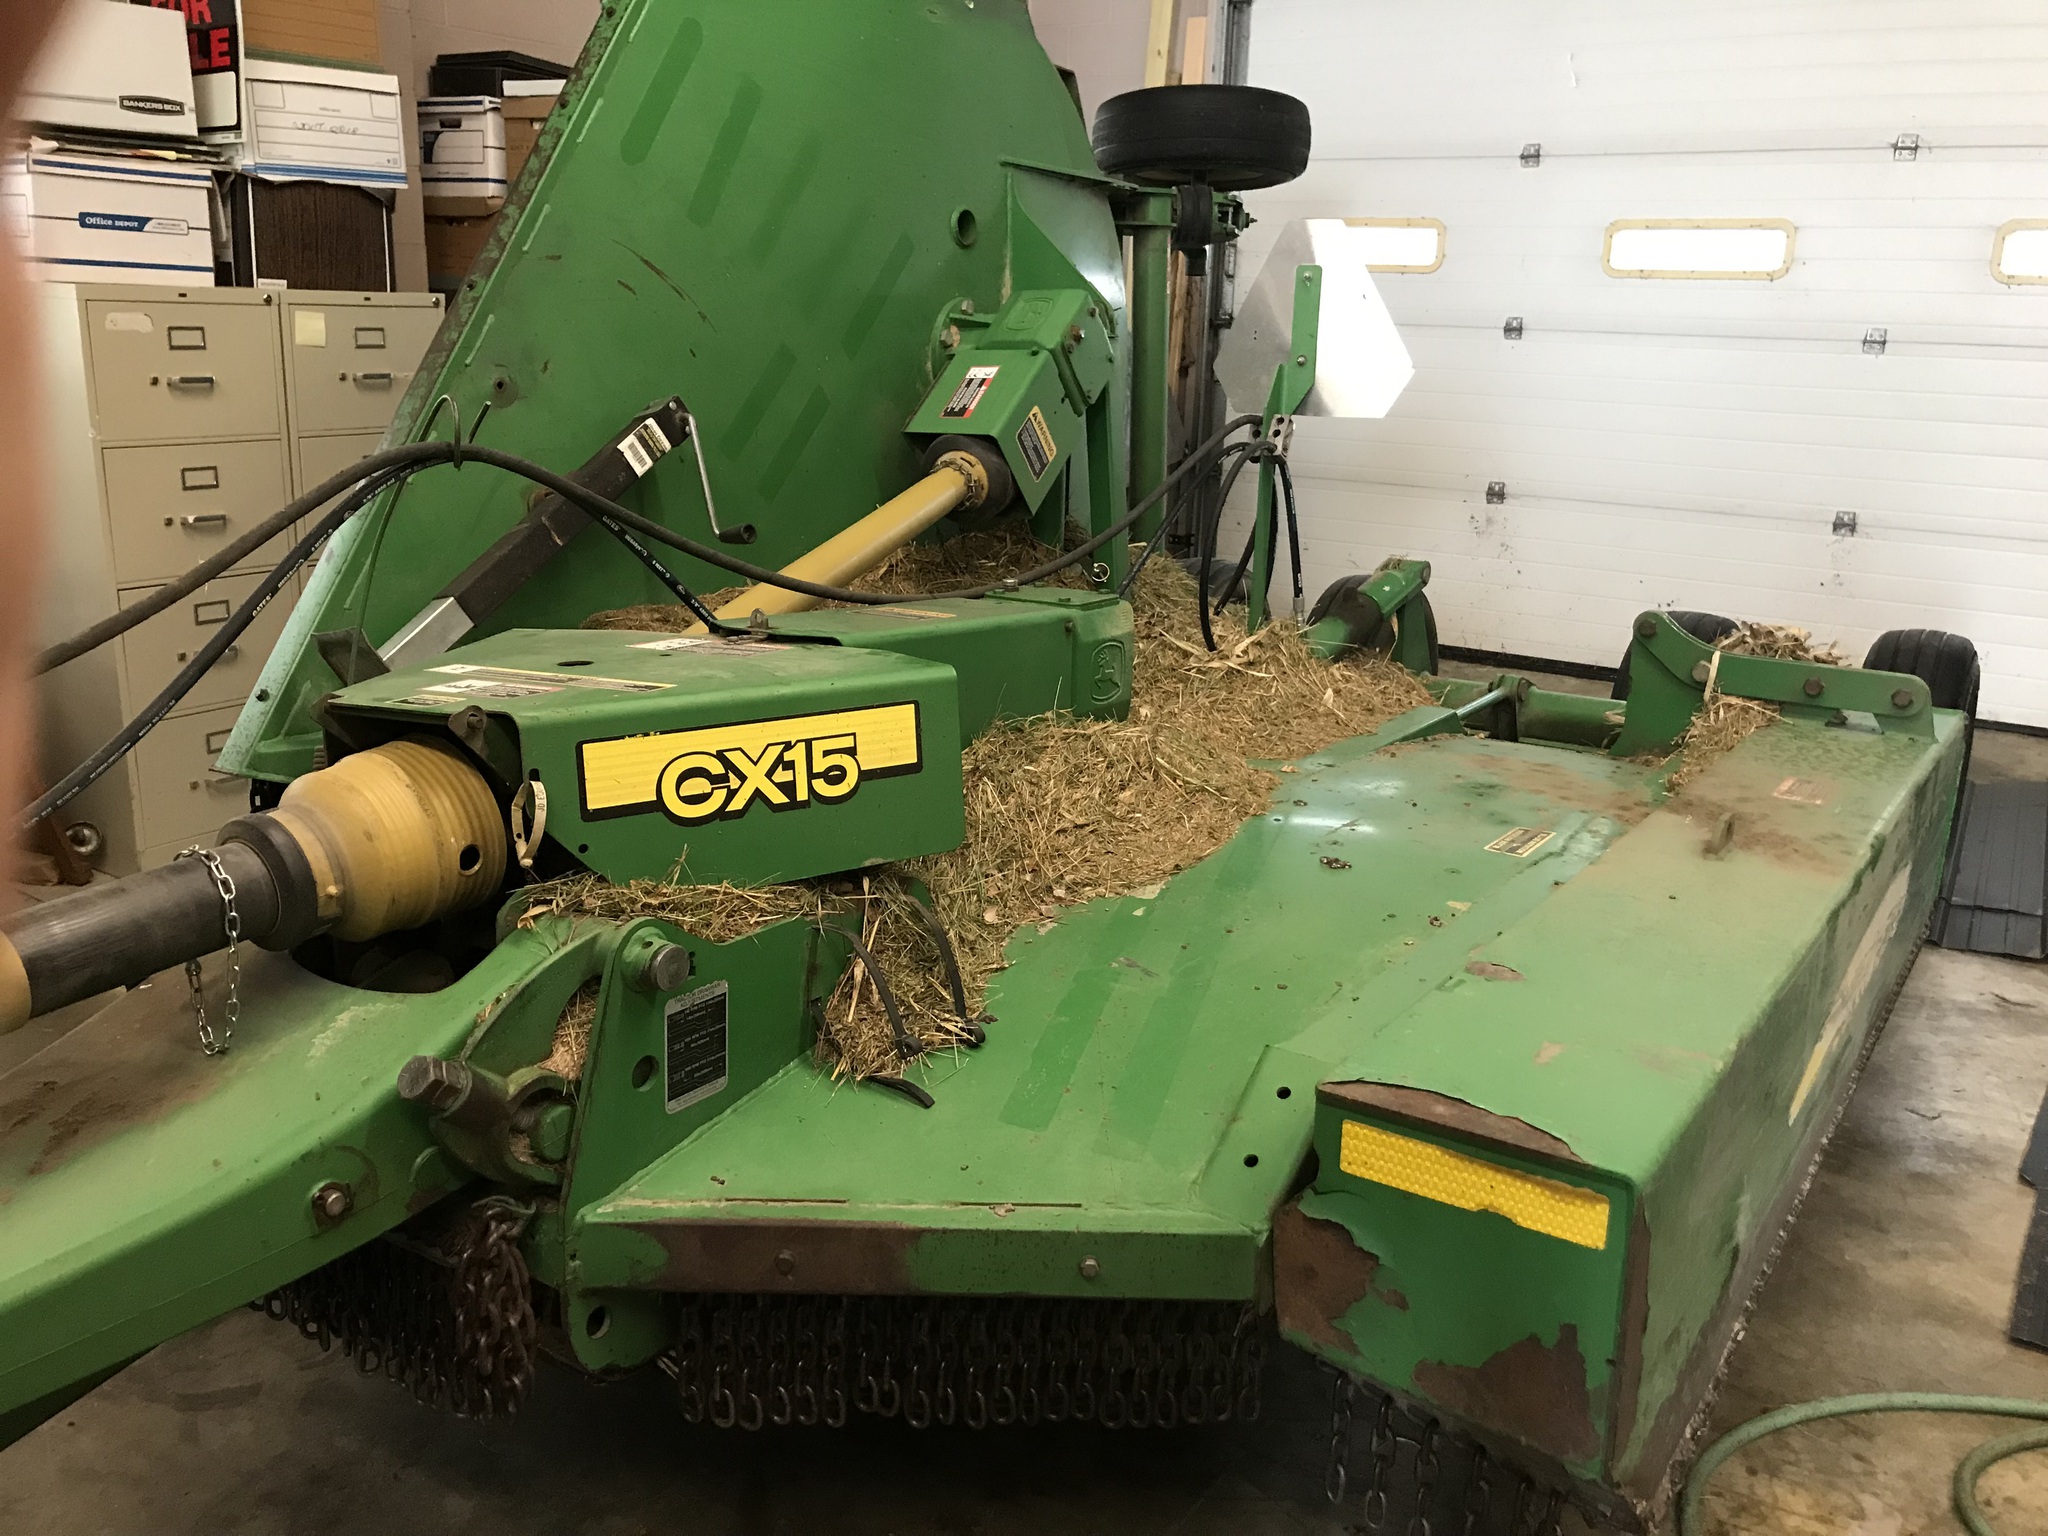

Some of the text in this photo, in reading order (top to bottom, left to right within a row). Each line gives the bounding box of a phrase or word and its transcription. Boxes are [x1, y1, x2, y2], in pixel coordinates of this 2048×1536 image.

[122, 99, 182, 111] BANKERS BOX
[85, 216, 139, 228] Office DEPOT
[658, 733, 861, 824] CX15
